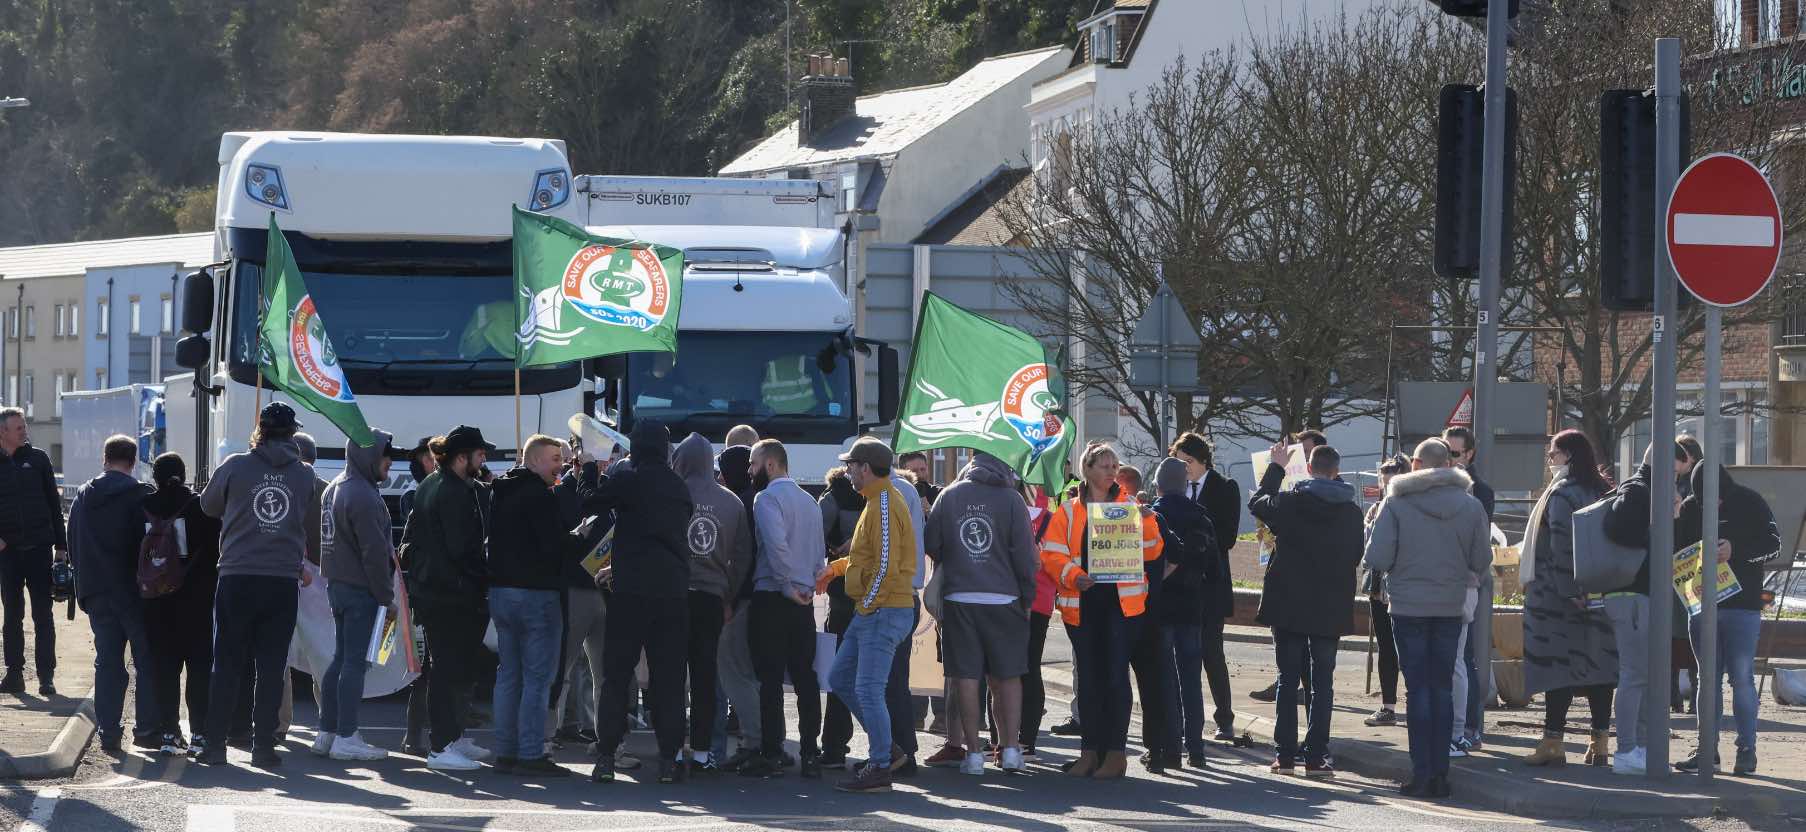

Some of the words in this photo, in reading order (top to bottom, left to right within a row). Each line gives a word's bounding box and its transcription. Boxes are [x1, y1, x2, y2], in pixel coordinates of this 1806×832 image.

[636, 193, 692, 206] SUKB107
[567, 260, 585, 289] SAVE
[582, 245, 606, 261] OUR
[637, 249, 665, 307] SEAFARERS
[601, 277, 635, 291] RMT
[1480, 311, 1486, 322] 5
[1654, 317, 1661, 330] 6
[1007, 380, 1025, 406] SAVE
[1021, 367, 1044, 383] OUR
[1023, 425, 1041, 440] SO
[1094, 524, 1118, 534] STOP
[1121, 524, 1138, 534] THE
[1091, 540, 1112, 550] P&O
[1114, 540, 1140, 550] JOBS
[1091, 558, 1125, 569] CARVE
[1127, 558, 1140, 569] UP
